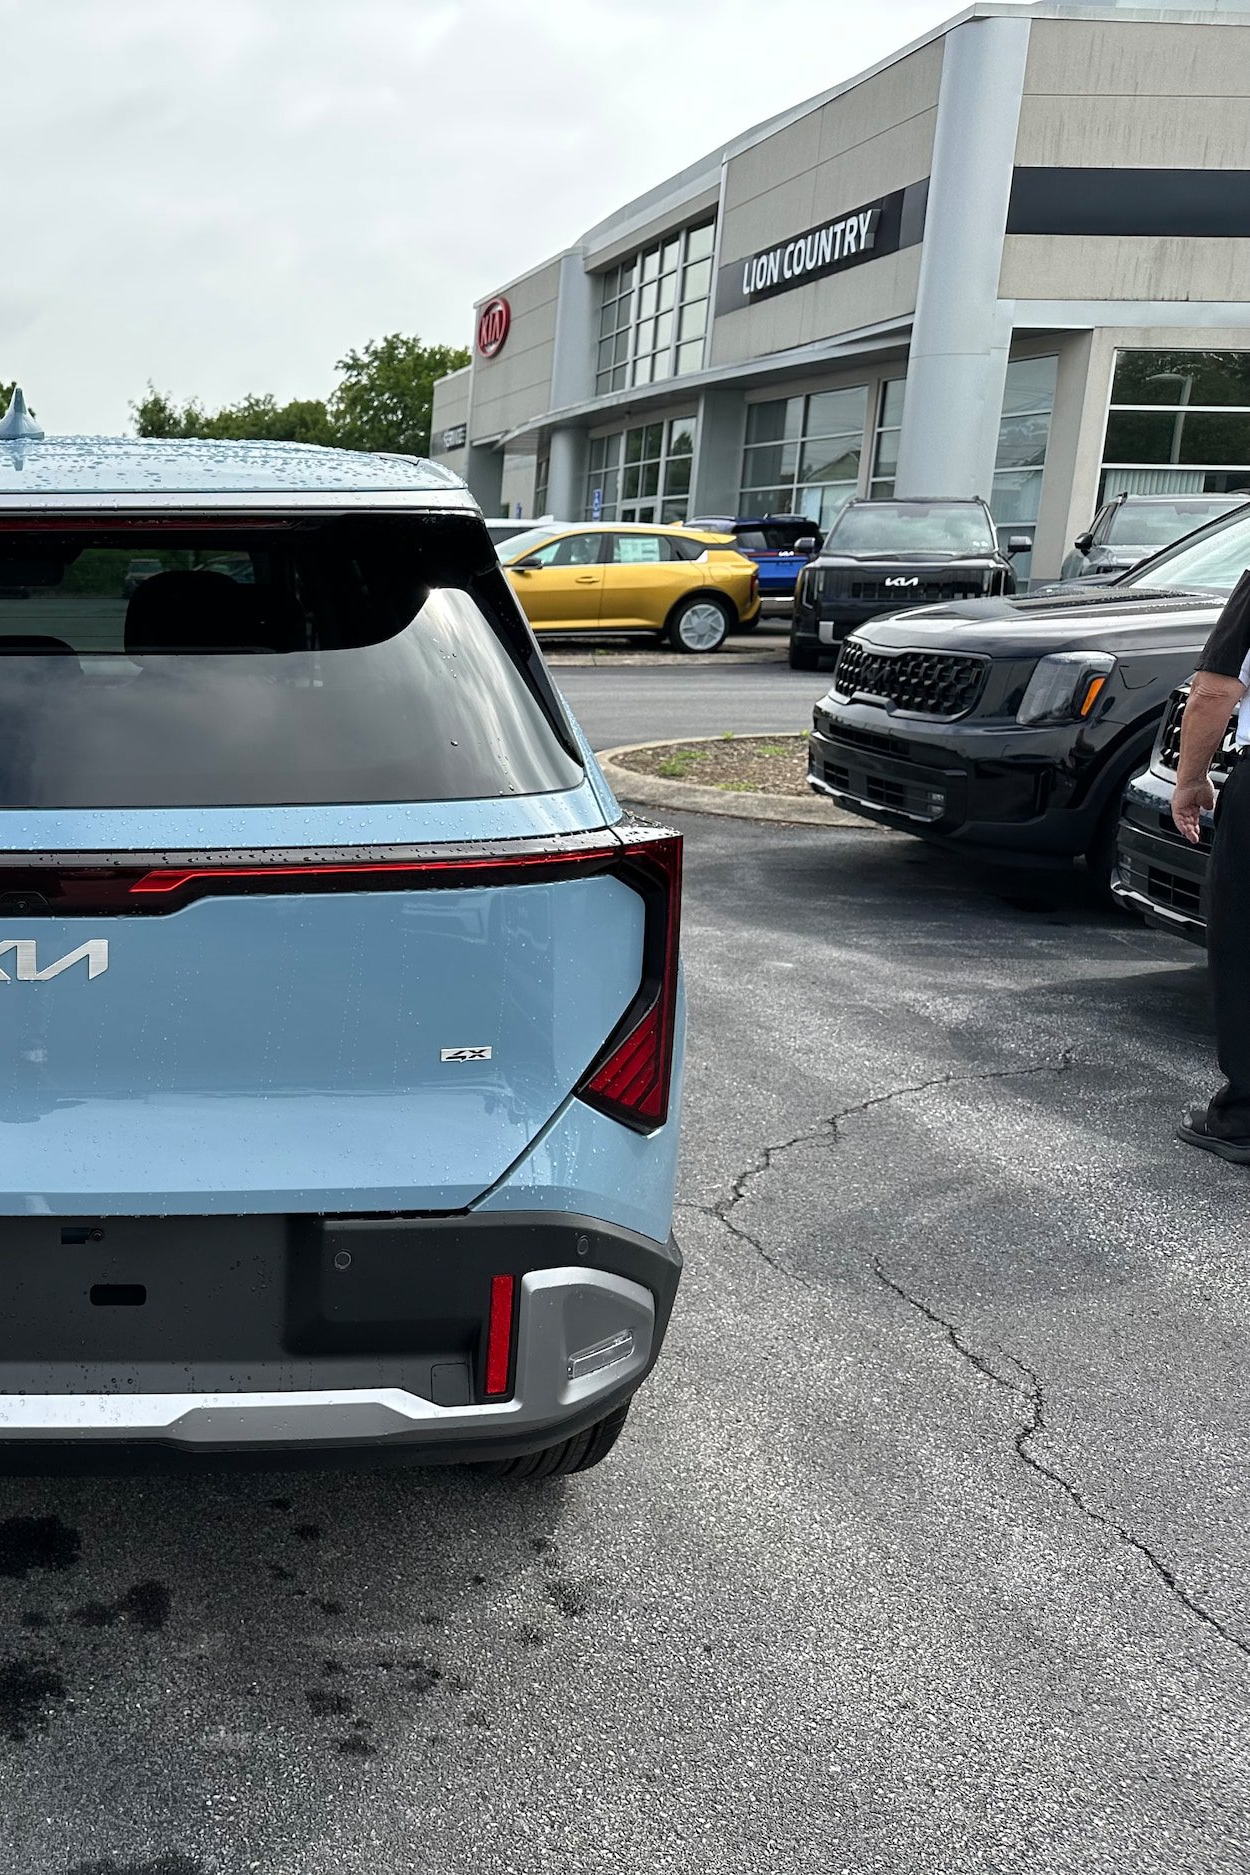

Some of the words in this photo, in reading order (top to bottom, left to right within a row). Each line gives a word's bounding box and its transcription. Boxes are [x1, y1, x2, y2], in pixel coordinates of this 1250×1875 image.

[742, 248, 781, 295] LION
[783, 209, 874, 280] COUNTRY
[885, 576, 919, 587] KIA
